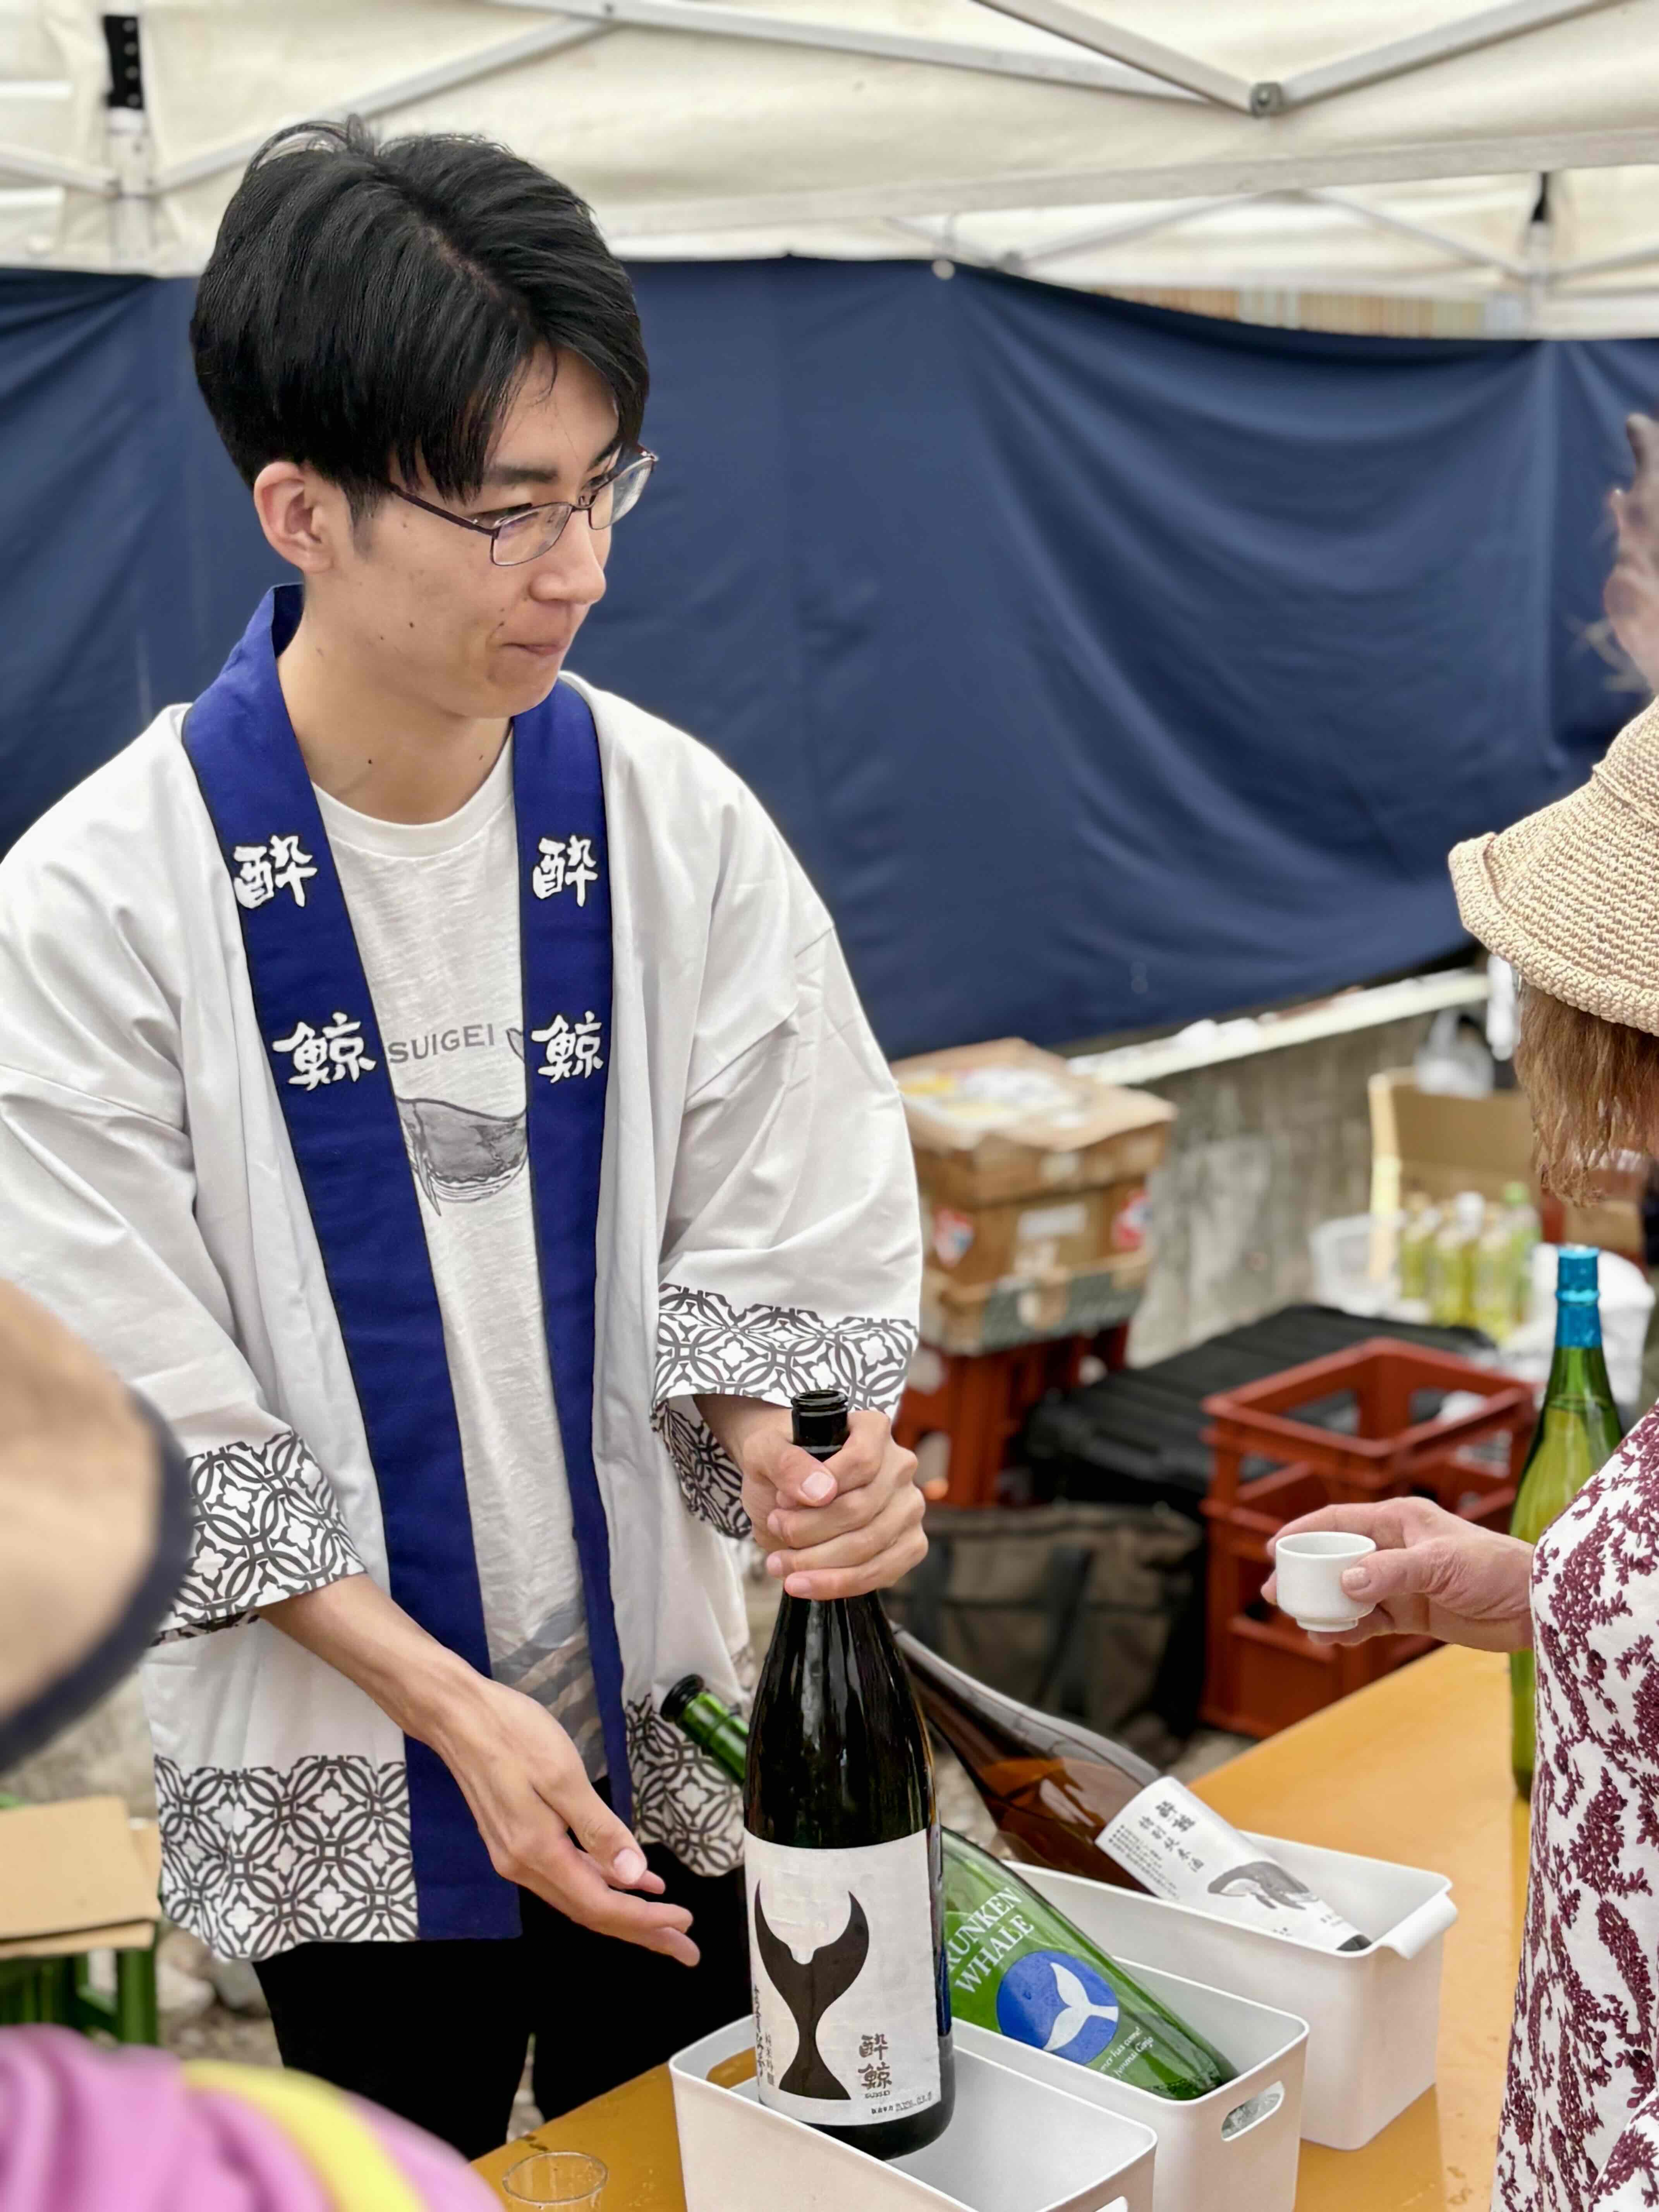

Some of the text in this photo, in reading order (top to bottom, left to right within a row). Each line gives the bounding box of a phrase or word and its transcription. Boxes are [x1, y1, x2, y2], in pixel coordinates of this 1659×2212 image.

[232, 835, 376, 1091] 酔鯨
[531, 835, 603, 1083] 酔鯨
[388, 1024, 495, 1063] SUIGEI
[946, 1887, 1022, 1973] RUNKEN
[954, 1914, 1035, 1993] WHALE
[858, 2033, 892, 2089] 酔鯨
